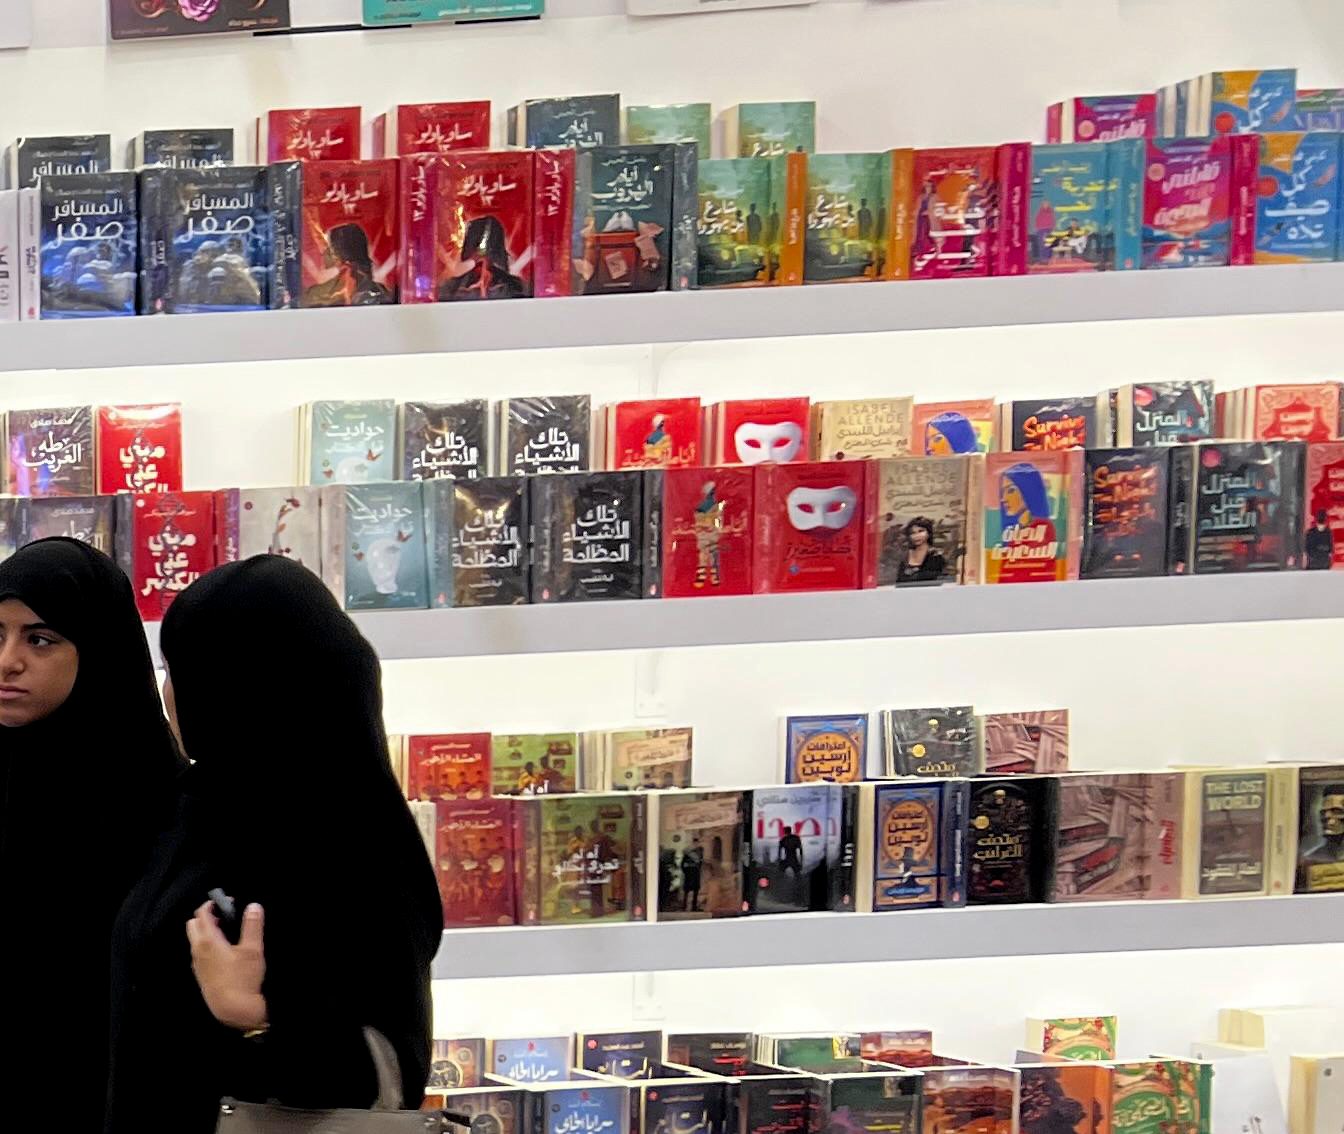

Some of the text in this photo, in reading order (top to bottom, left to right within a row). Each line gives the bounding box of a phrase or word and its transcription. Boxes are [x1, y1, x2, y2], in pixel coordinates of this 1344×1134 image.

[52, 199, 124, 221] المسافر
[185, 193, 254, 215] المسافر
[54, 216, 124, 247] صفر
[186, 212, 255, 237] صفر
[838, 414, 904, 426] ALLENDE
[23, 443, 82, 473] الغريب
[412, 447, 478, 469] الأشياء
[515, 443, 580, 465] الأشياء
[562, 520, 630, 541] الأشياء
[1205, 780, 1264, 795] THE LOST
[1207, 794, 1263, 811] WORLD
